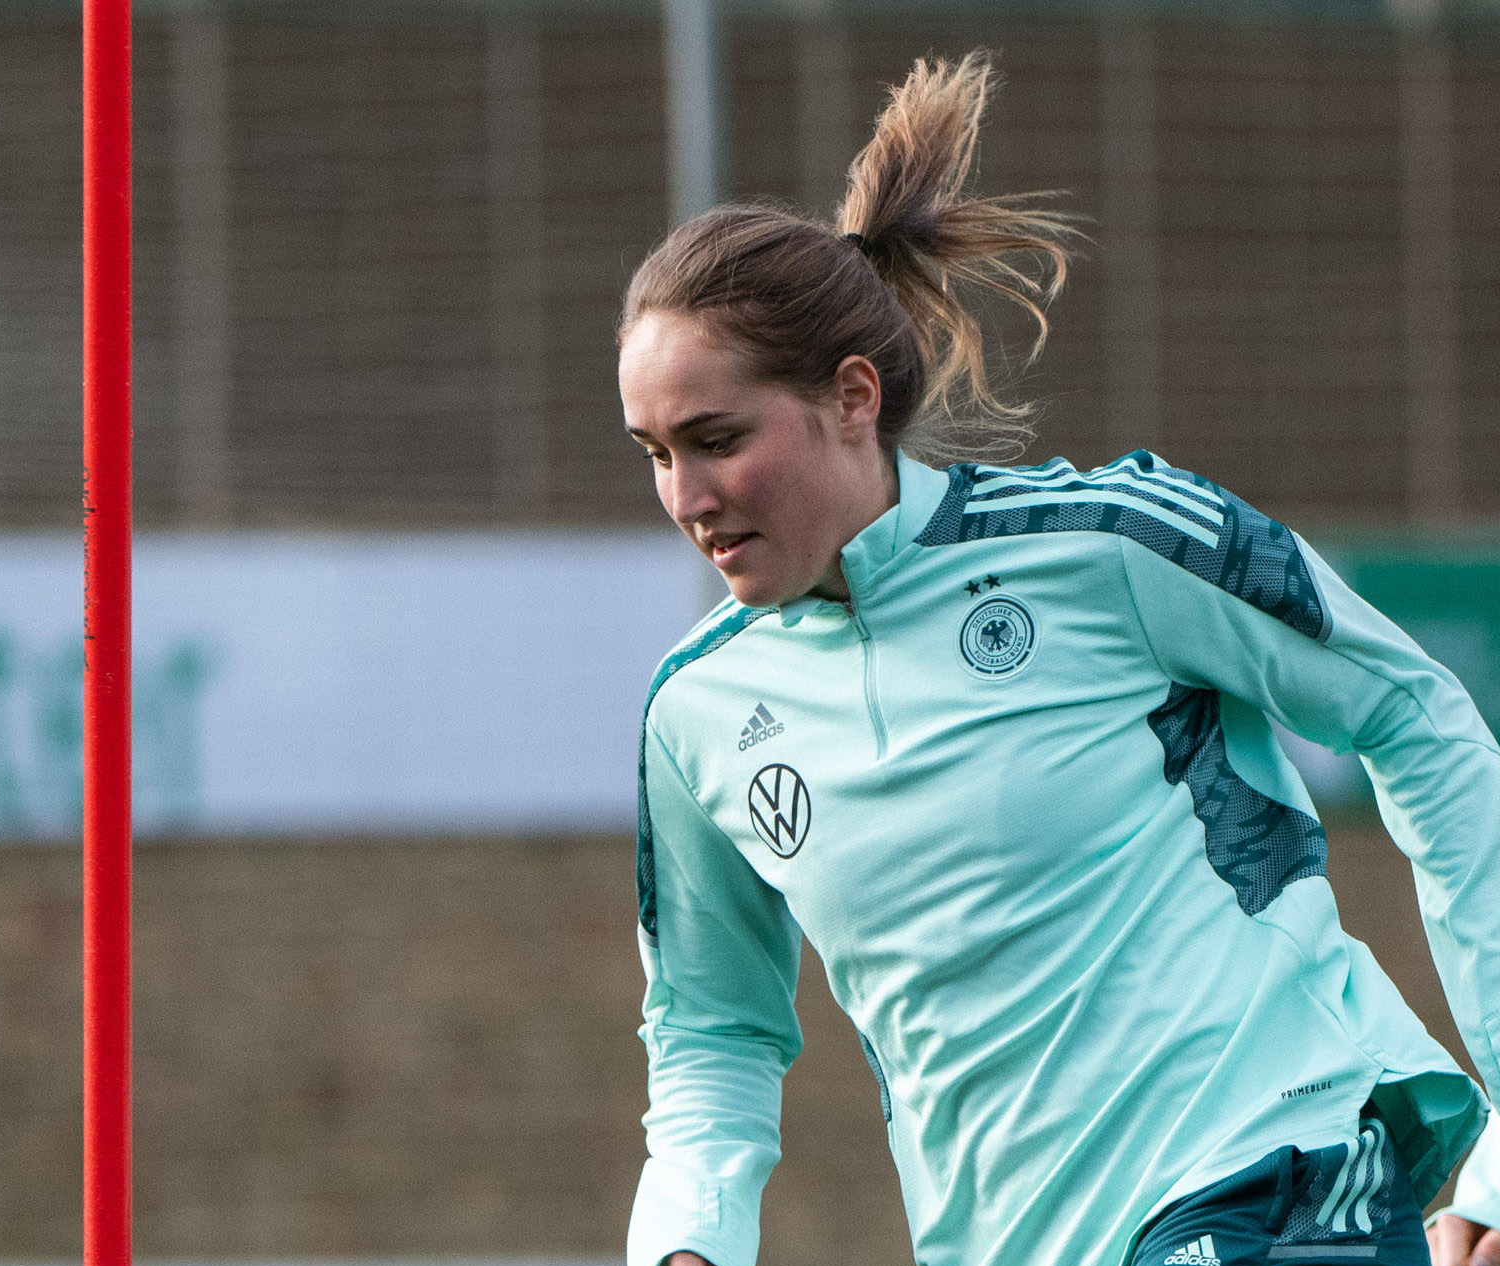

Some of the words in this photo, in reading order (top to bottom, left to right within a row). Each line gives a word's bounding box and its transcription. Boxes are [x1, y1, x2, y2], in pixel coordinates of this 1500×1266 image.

[972, 606, 1013, 629] DEUTSCHER
[738, 722, 785, 752] adidas
[748, 764, 808, 855] VW
[1280, 1080, 1333, 1100] PRIMEBLUE
